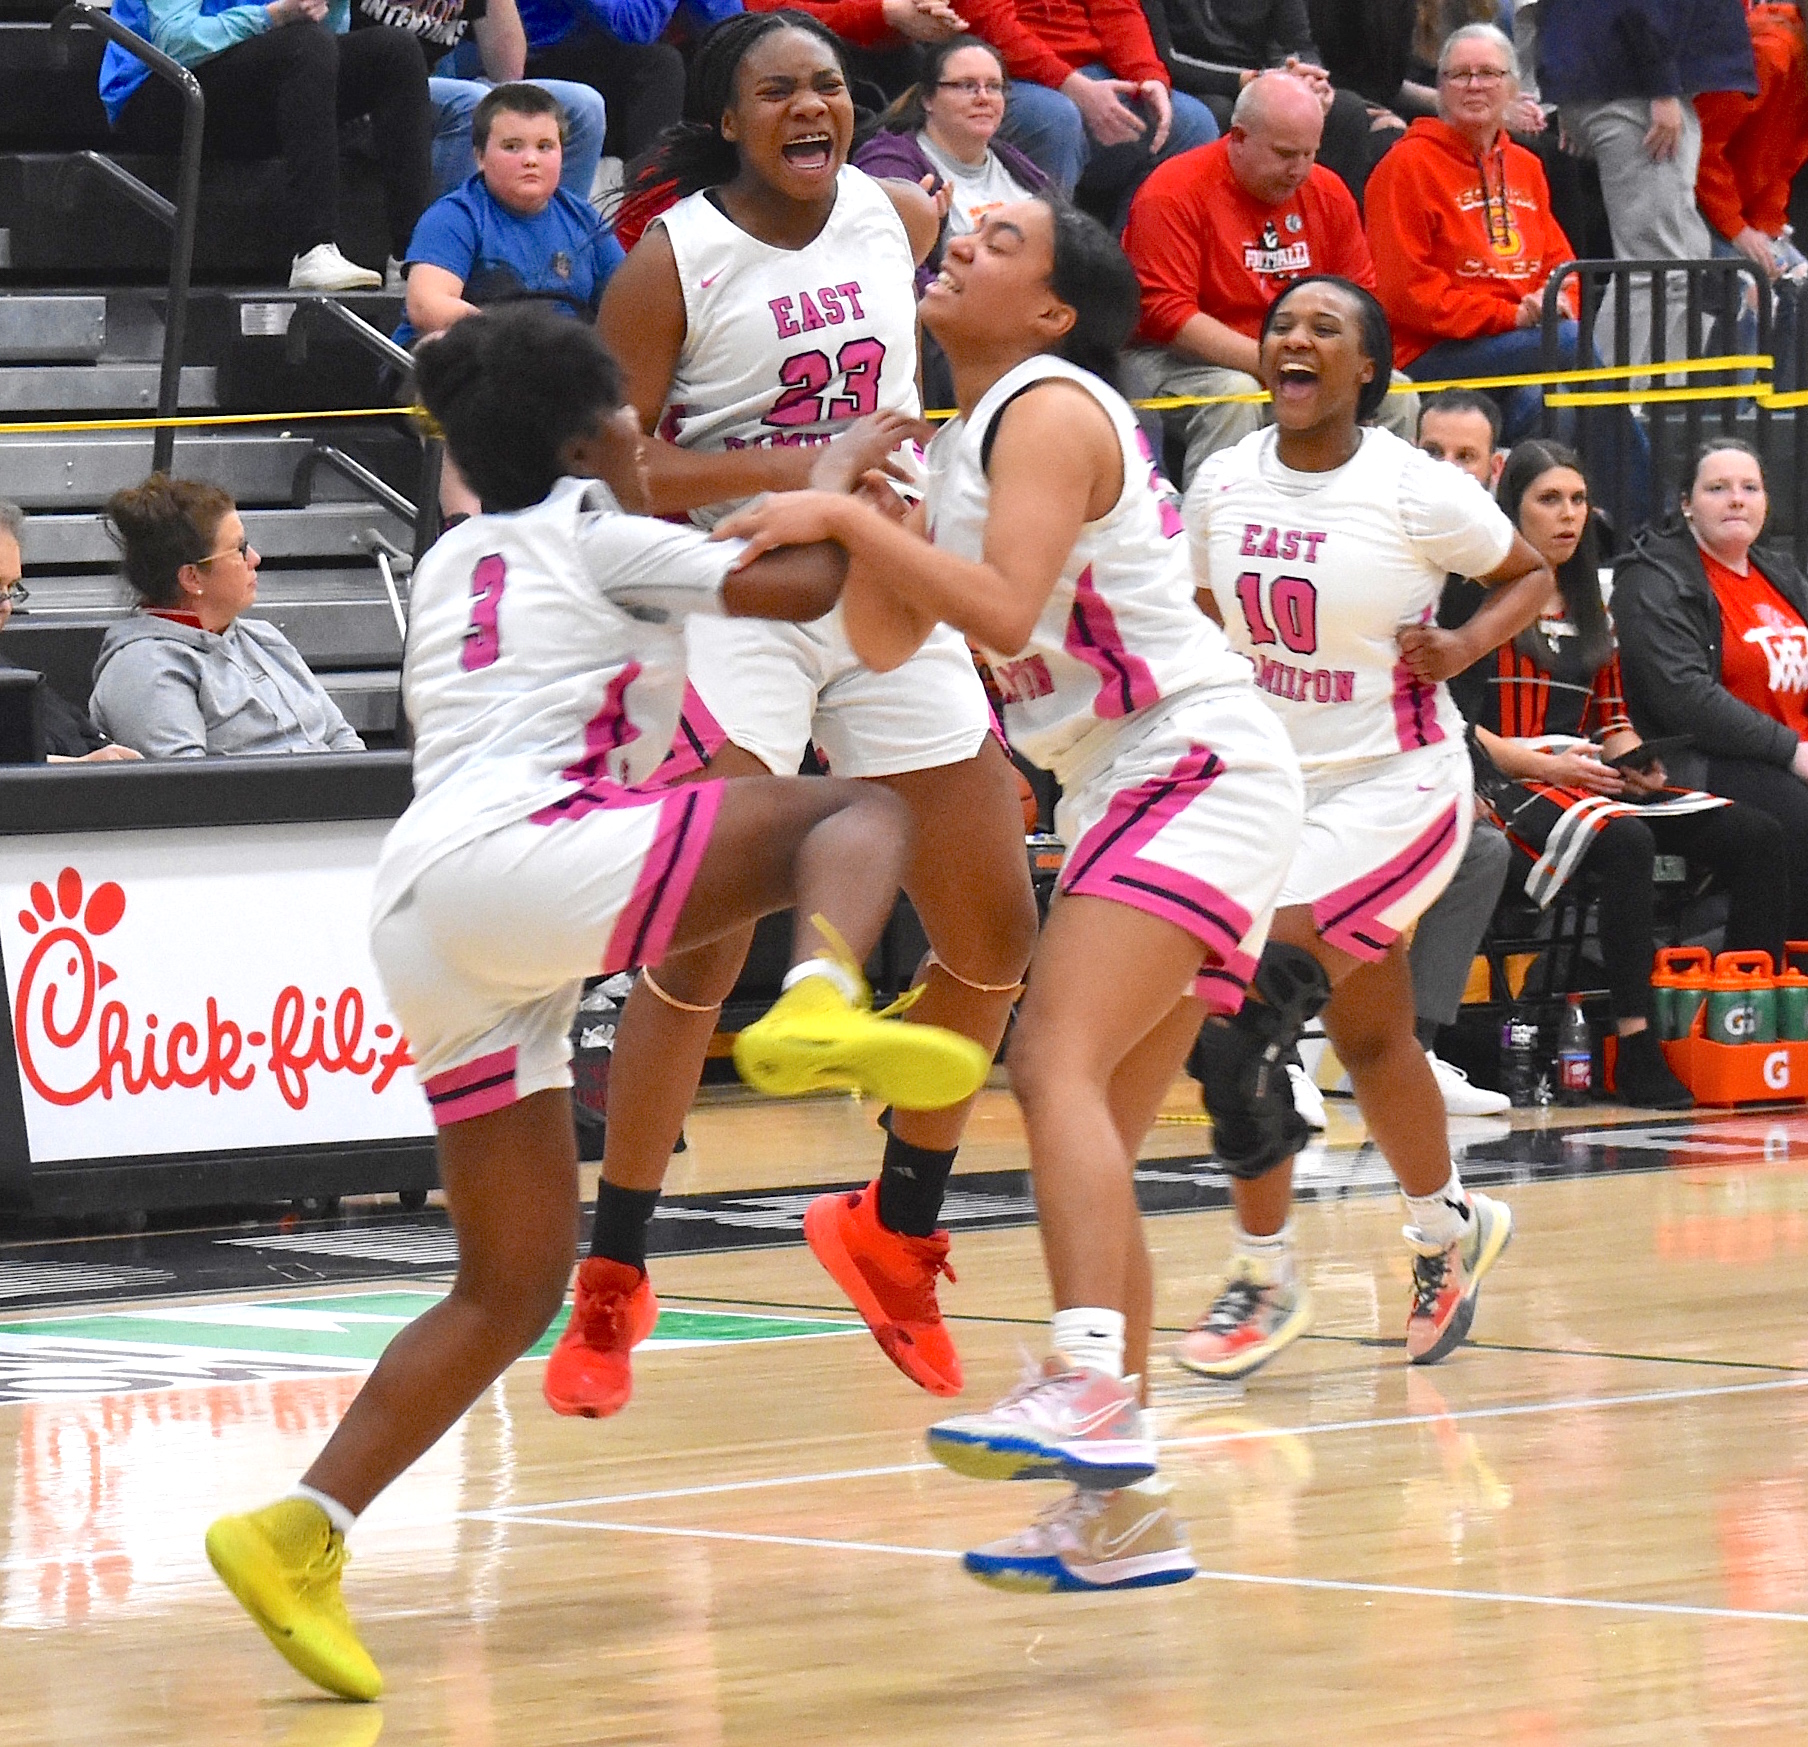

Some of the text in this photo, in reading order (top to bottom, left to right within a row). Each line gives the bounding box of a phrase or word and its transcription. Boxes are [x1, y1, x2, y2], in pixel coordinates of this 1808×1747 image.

[768, 281, 865, 340] EAST
[761, 336, 886, 427] 23
[1239, 523, 1327, 564] EAST
[460, 552, 506, 672] 3
[1235, 571, 1317, 656] 10
[1763, 1051, 1790, 1090] G
